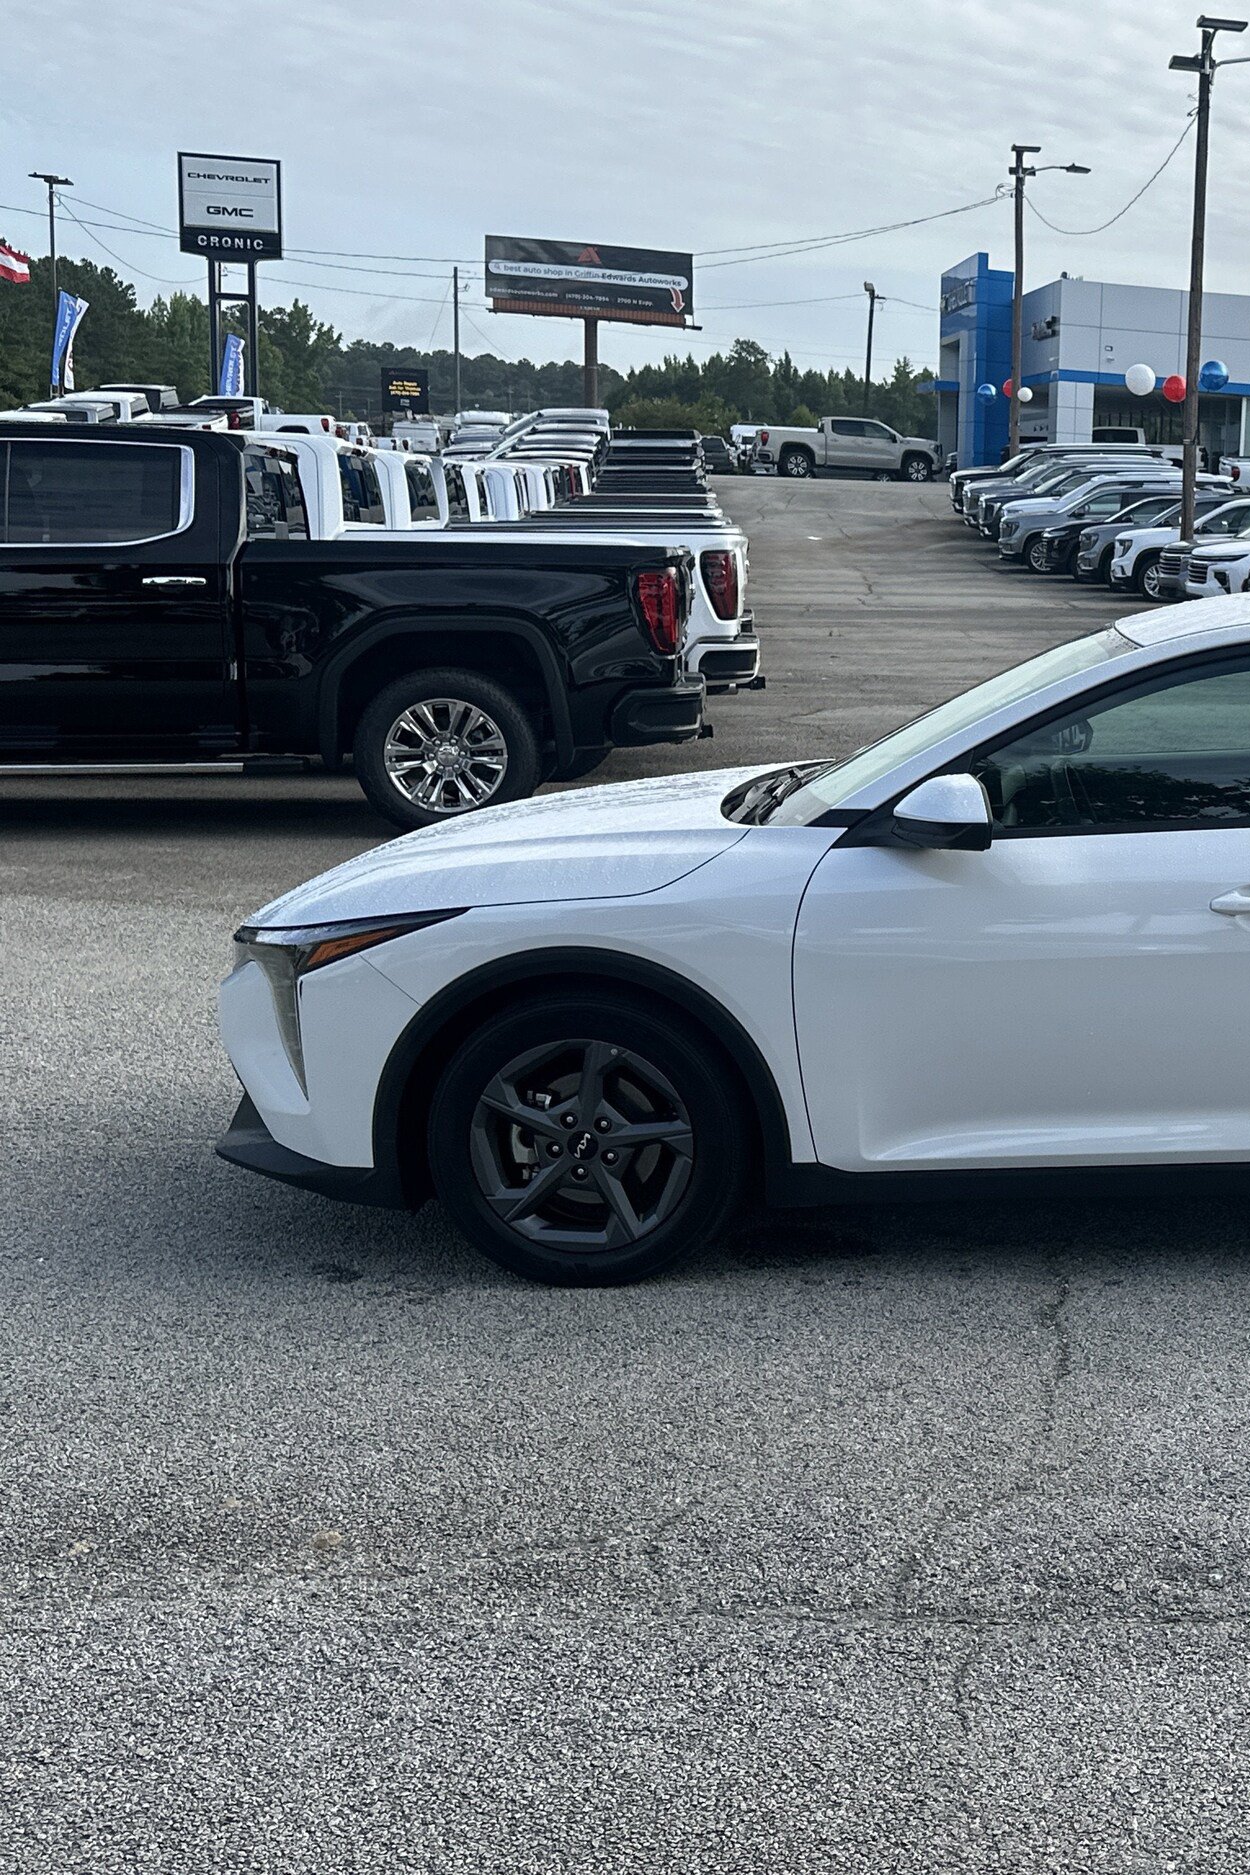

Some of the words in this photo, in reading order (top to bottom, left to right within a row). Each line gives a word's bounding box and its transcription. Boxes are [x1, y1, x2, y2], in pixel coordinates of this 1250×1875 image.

[187, 172, 271, 184] CHEVROLET
[206, 205, 254, 218] GMC
[197, 234, 264, 250] CRONIC
[503, 264, 521, 273] best
[523, 266, 542, 274] auto
[543, 267, 563, 277] shop
[564, 268, 573, 277] in
[601, 272, 637, 283] Edwards
[638, 276, 682, 287] Autoworks
